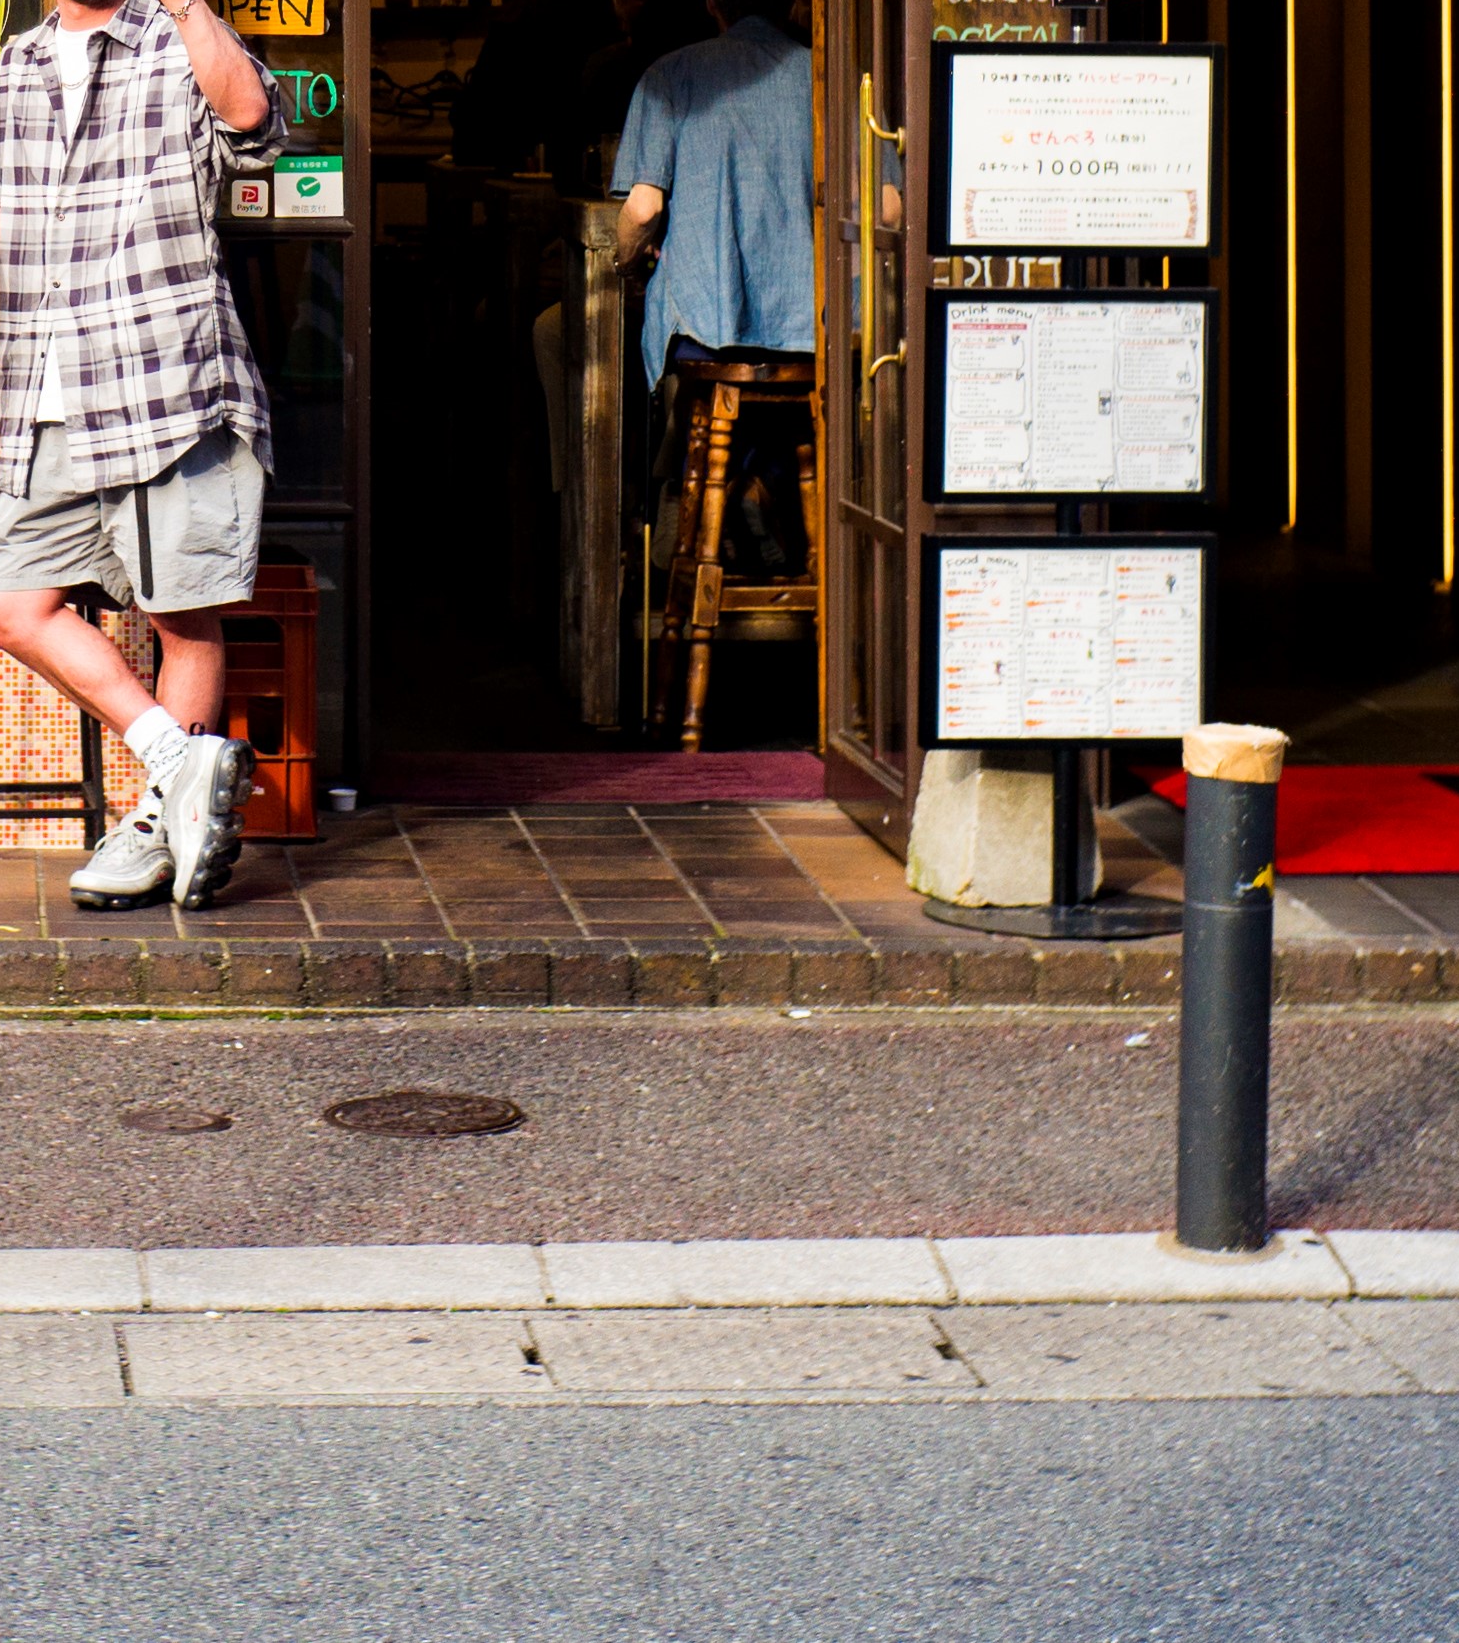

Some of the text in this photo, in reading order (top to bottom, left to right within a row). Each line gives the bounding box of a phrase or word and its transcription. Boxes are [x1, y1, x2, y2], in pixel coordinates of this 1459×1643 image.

[1029, 130, 1096, 146] せんべろ
[1036, 159, 1120, 176] 1000円
[236, 203, 264, 212] PayPay
[950, 304, 1033, 320] Drink menu
